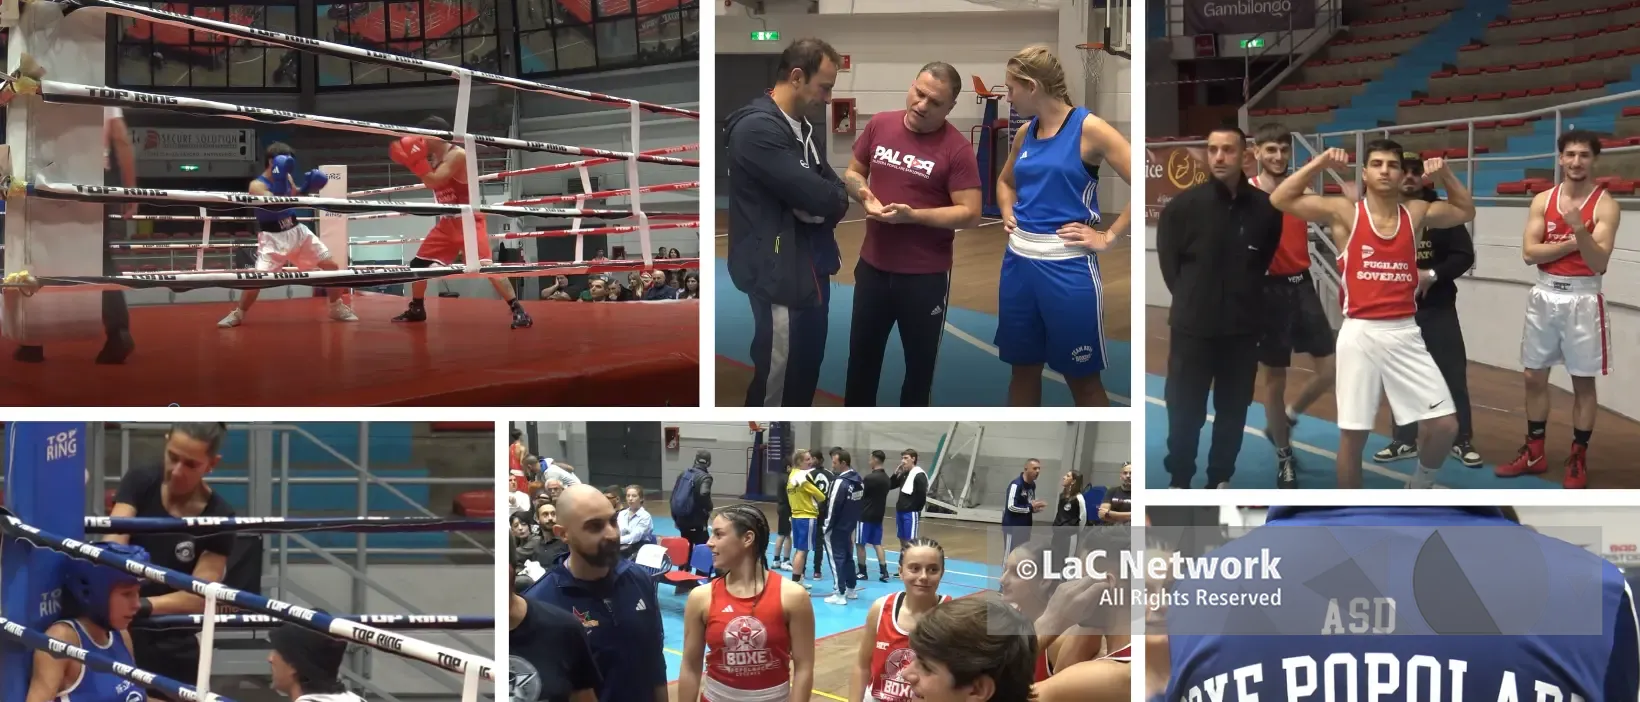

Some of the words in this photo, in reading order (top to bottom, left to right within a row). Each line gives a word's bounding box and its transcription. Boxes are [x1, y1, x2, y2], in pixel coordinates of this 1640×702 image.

[1203, 0, 1291, 17] Gambilongo
[85, 86, 129, 100] TOP
[134, 91, 178, 105] RING
[873, 145, 902, 166] PAL
[72, 184, 117, 196] TOP
[123, 187, 168, 197] RING
[226, 194, 260, 203] TOP
[1363, 261, 1408, 270] PUGILATO
[236, 271, 269, 281] TOP
[274, 271, 309, 280] RING
[1356, 271, 1412, 282] SOVERATO
[46, 428, 77, 445] TOP
[46, 438, 77, 462] RING
[182, 517, 229, 526] TOP
[40, 588, 62, 601] TO
[39, 599, 62, 618] RIN
[266, 598, 292, 613] TOP
[288, 605, 318, 622] RING
[1321, 597, 1396, 635] ASD
[360, 614, 403, 623] TOP
[408, 614, 458, 623] RING
[4, 621, 26, 638] RING
[352, 626, 375, 642] TOP
[376, 633, 404, 652] RING
[48, 638, 67, 653] TOP
[66, 644, 90, 661] RING
[726, 650, 768, 666] BOXE
[112, 661, 134, 676] TOP
[437, 652, 465, 668] TOP
[1282, 652, 1586, 702] POPOLA
